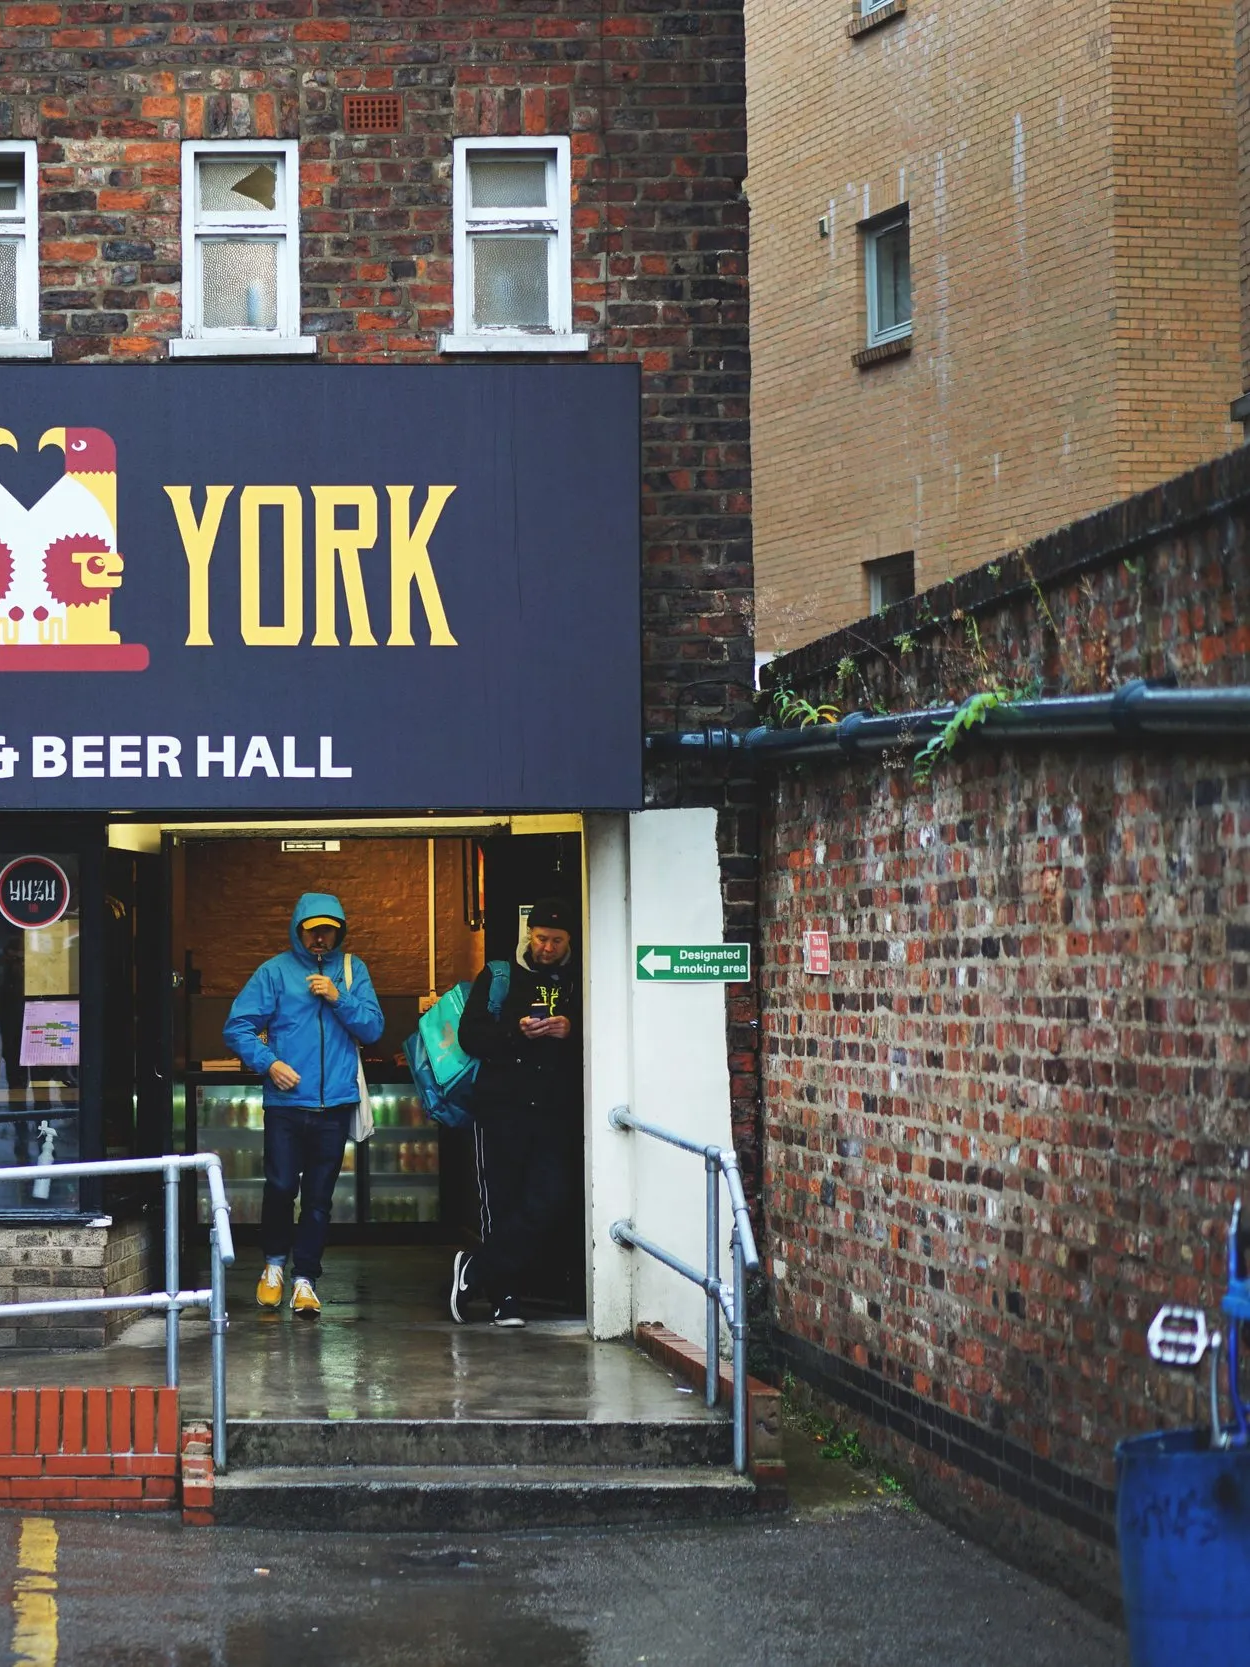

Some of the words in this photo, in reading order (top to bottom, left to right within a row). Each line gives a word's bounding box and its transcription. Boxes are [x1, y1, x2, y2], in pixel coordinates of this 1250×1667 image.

[163, 485, 458, 646] YORK
[32, 736, 182, 778] BEER
[197, 736, 352, 778] HALL
[679, 949, 740, 961] Designated
[673, 963, 719, 975] smoking
[722, 964, 746, 974] area
